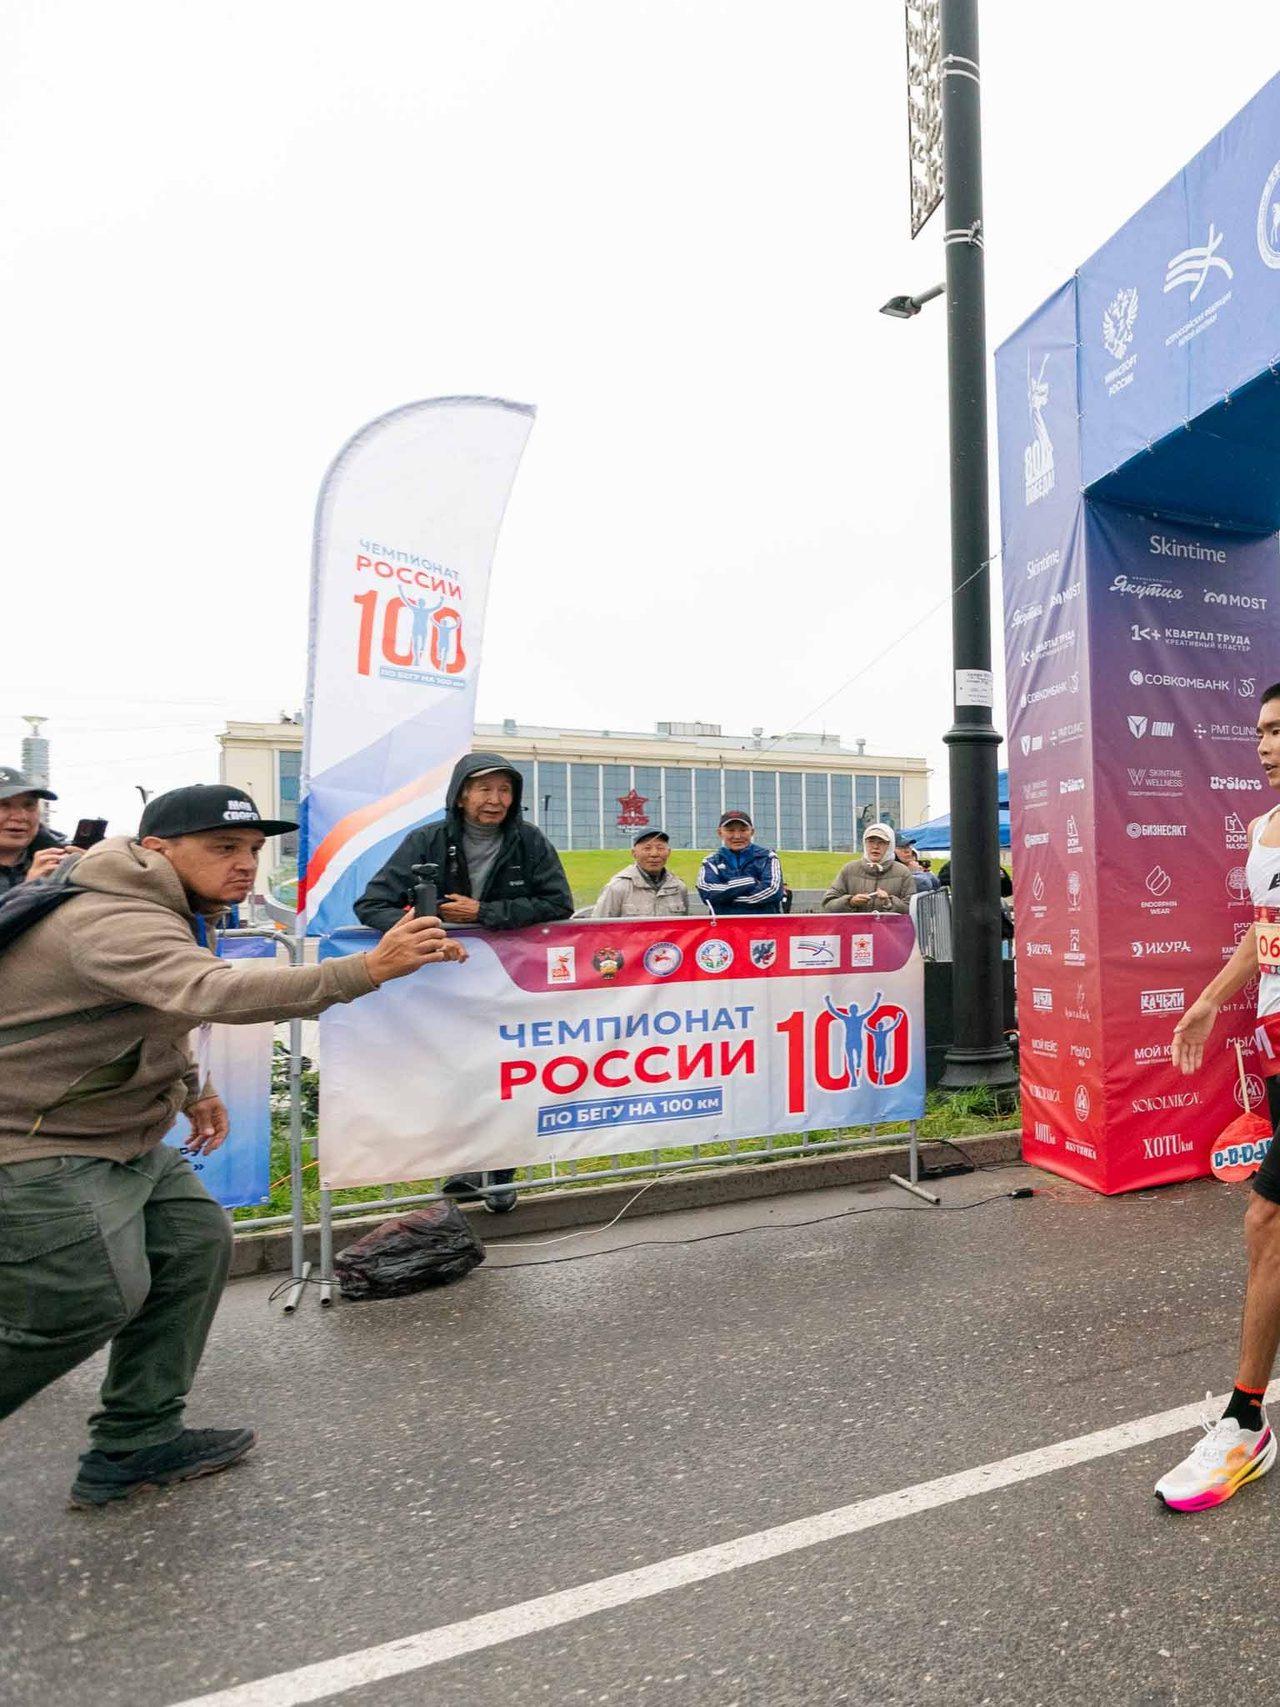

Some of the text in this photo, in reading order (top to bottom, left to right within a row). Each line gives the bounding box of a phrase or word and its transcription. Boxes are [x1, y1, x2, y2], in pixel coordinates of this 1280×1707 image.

[359, 538, 460, 581] ЧЕМПИОНАТ
[1150, 535, 1227, 563] Skintime
[1026, 549, 1060, 579] Skintime
[356, 554, 462, 600] РОССИИ
[1109, 574, 1184, 600] Якутия
[1063, 582, 1081, 604] MOST
[1230, 594, 1267, 610] MOST
[354, 588, 467, 676] 100
[1165, 628, 1214, 641] КВАРТАЛ
[1216, 633, 1251, 645] ТРУДА
[1145, 674, 1231, 691] СОВКОМБАНК
[1211, 724, 1230, 735] PMT
[1145, 778, 1184, 788] WELLNESS
[1149, 769, 1182, 778] SKINTIME
[1226, 834, 1247, 843] DOM
[1141, 900, 1177, 908] ENDORPHIN
[1146, 941, 1191, 954] ИКУРА
[500, 1006, 755, 1048] ЧЕМПИОНАТ
[777, 1003, 909, 1113] 100
[1134, 1045, 1161, 1059] МОЙ
[500, 1040, 755, 1100] РОССИИ
[542, 1098, 719, 1127] ПО БЕГУ НА 100 км
